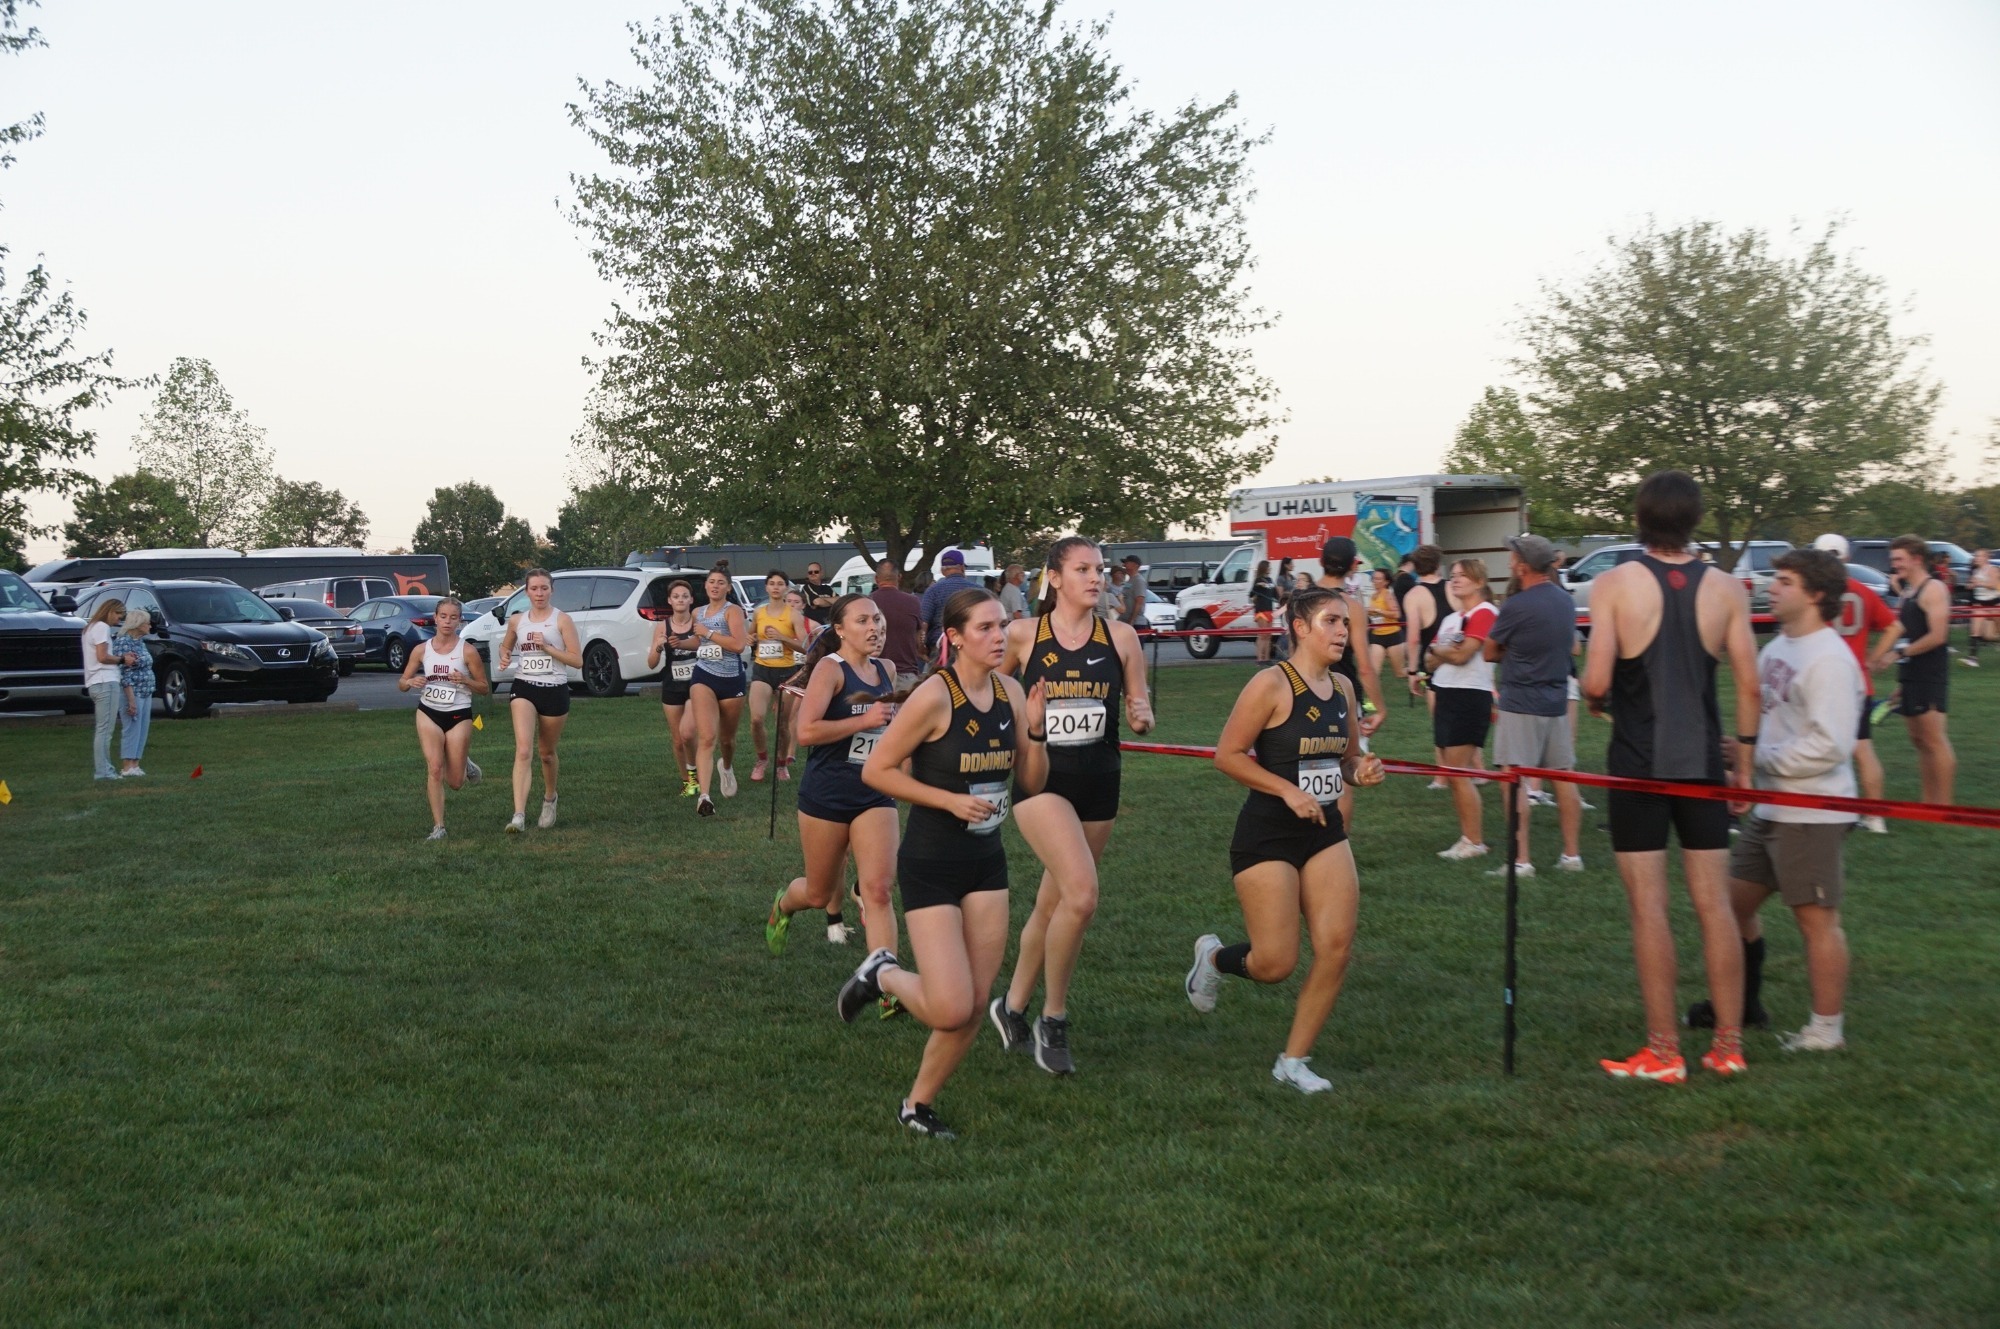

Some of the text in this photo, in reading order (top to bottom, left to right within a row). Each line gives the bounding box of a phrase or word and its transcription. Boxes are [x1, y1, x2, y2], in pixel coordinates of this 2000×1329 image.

[760, 645, 782, 655] 2034
[433, 664, 450, 674] OHIO
[523, 658, 552, 670] 2097
[425, 686, 455, 701] 2087
[1037, 681, 1110, 699] OMINICAN
[1048, 712, 1105, 735] 2047
[852, 736, 879, 756] 21
[1301, 773, 1343, 796] 2050
